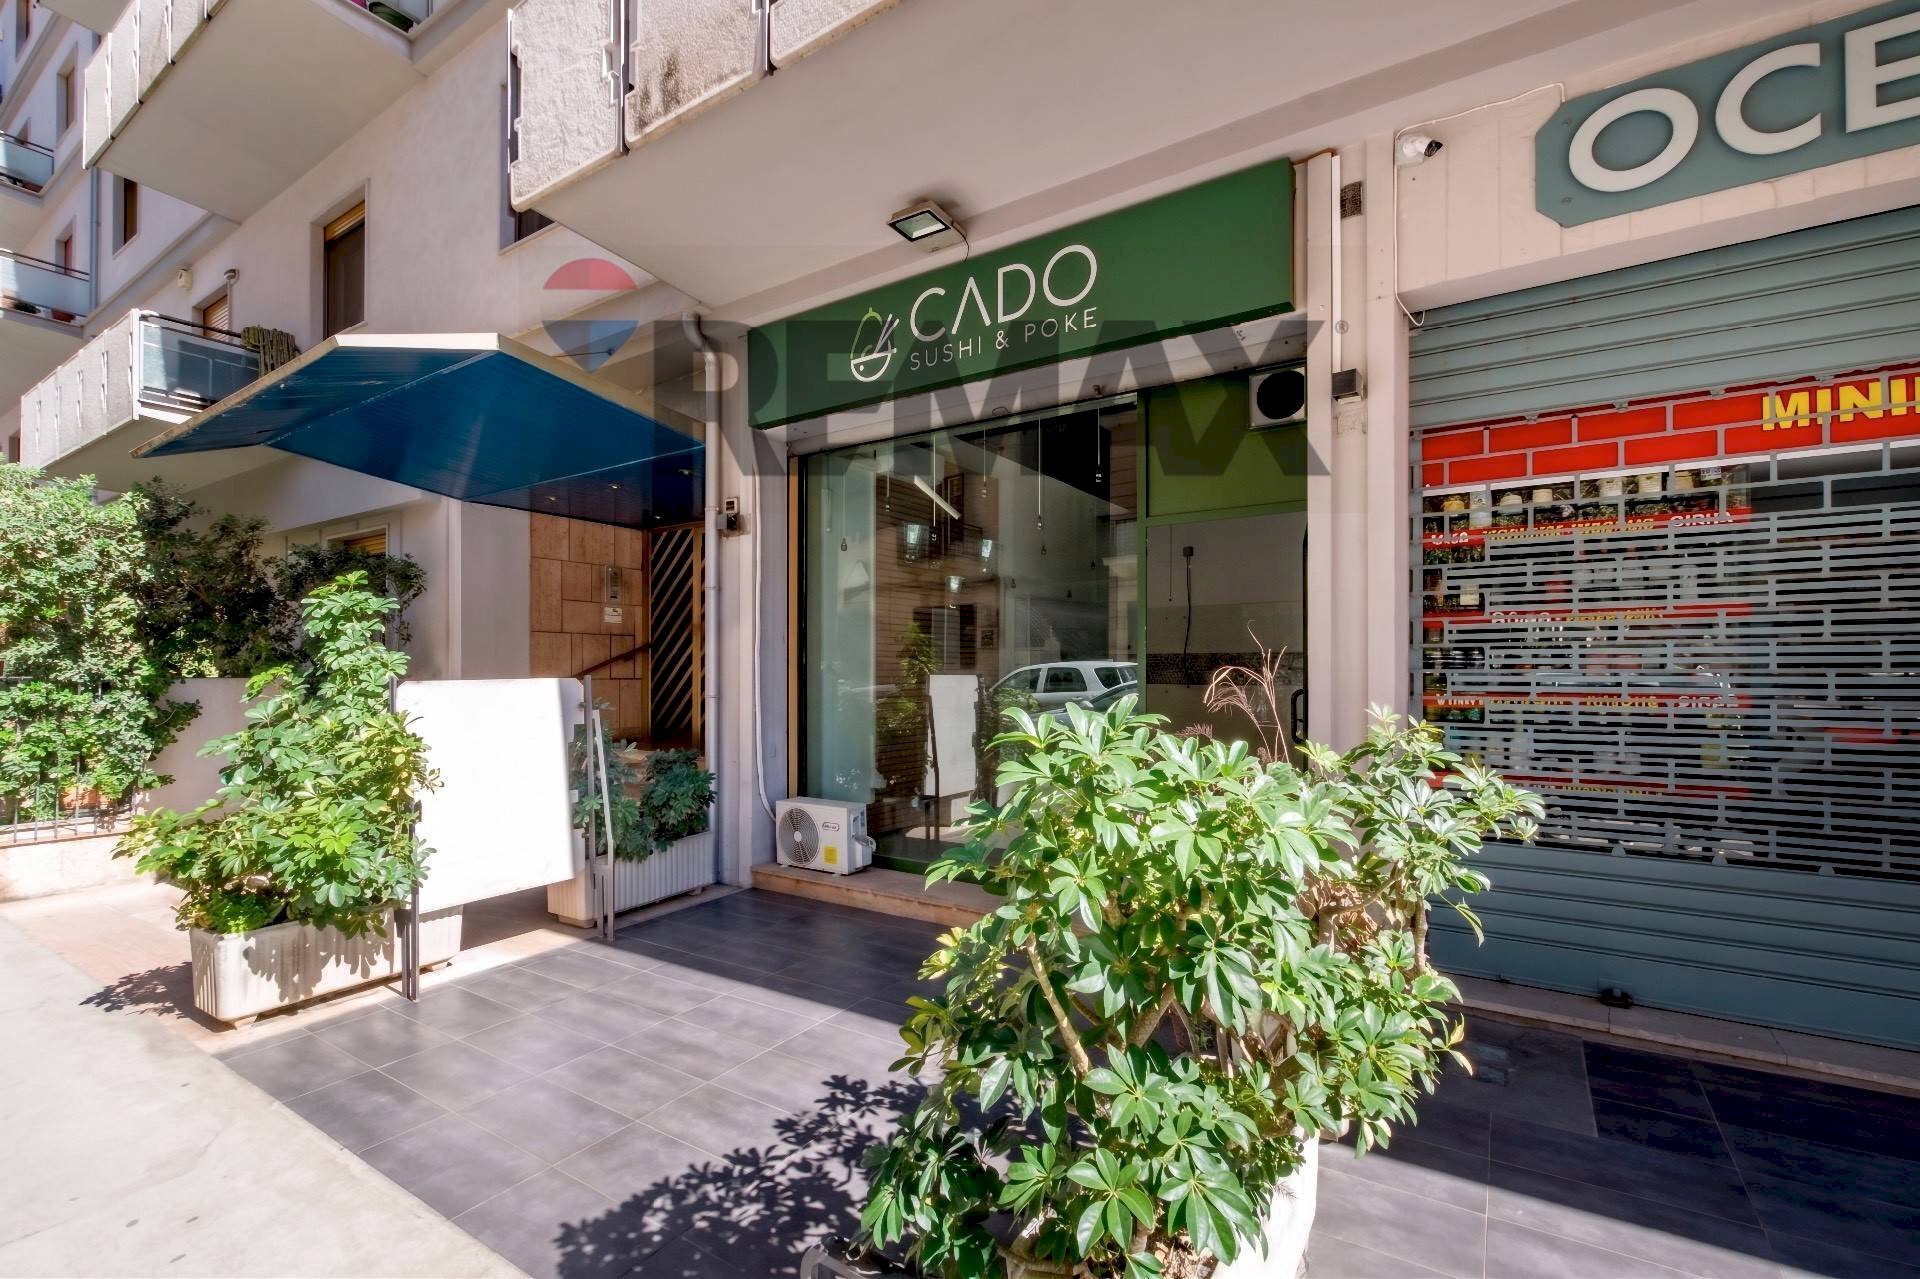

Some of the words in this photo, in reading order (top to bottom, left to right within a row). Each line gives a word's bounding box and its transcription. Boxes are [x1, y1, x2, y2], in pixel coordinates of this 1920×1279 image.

[1569, 11, 1920, 192] OCE
[910, 245, 1097, 341] CADO
[910, 336, 981, 371] SUSHI
[995, 330, 1010, 350] &
[1024, 306, 1097, 342] POKE
[1762, 376, 1920, 431] MINI
